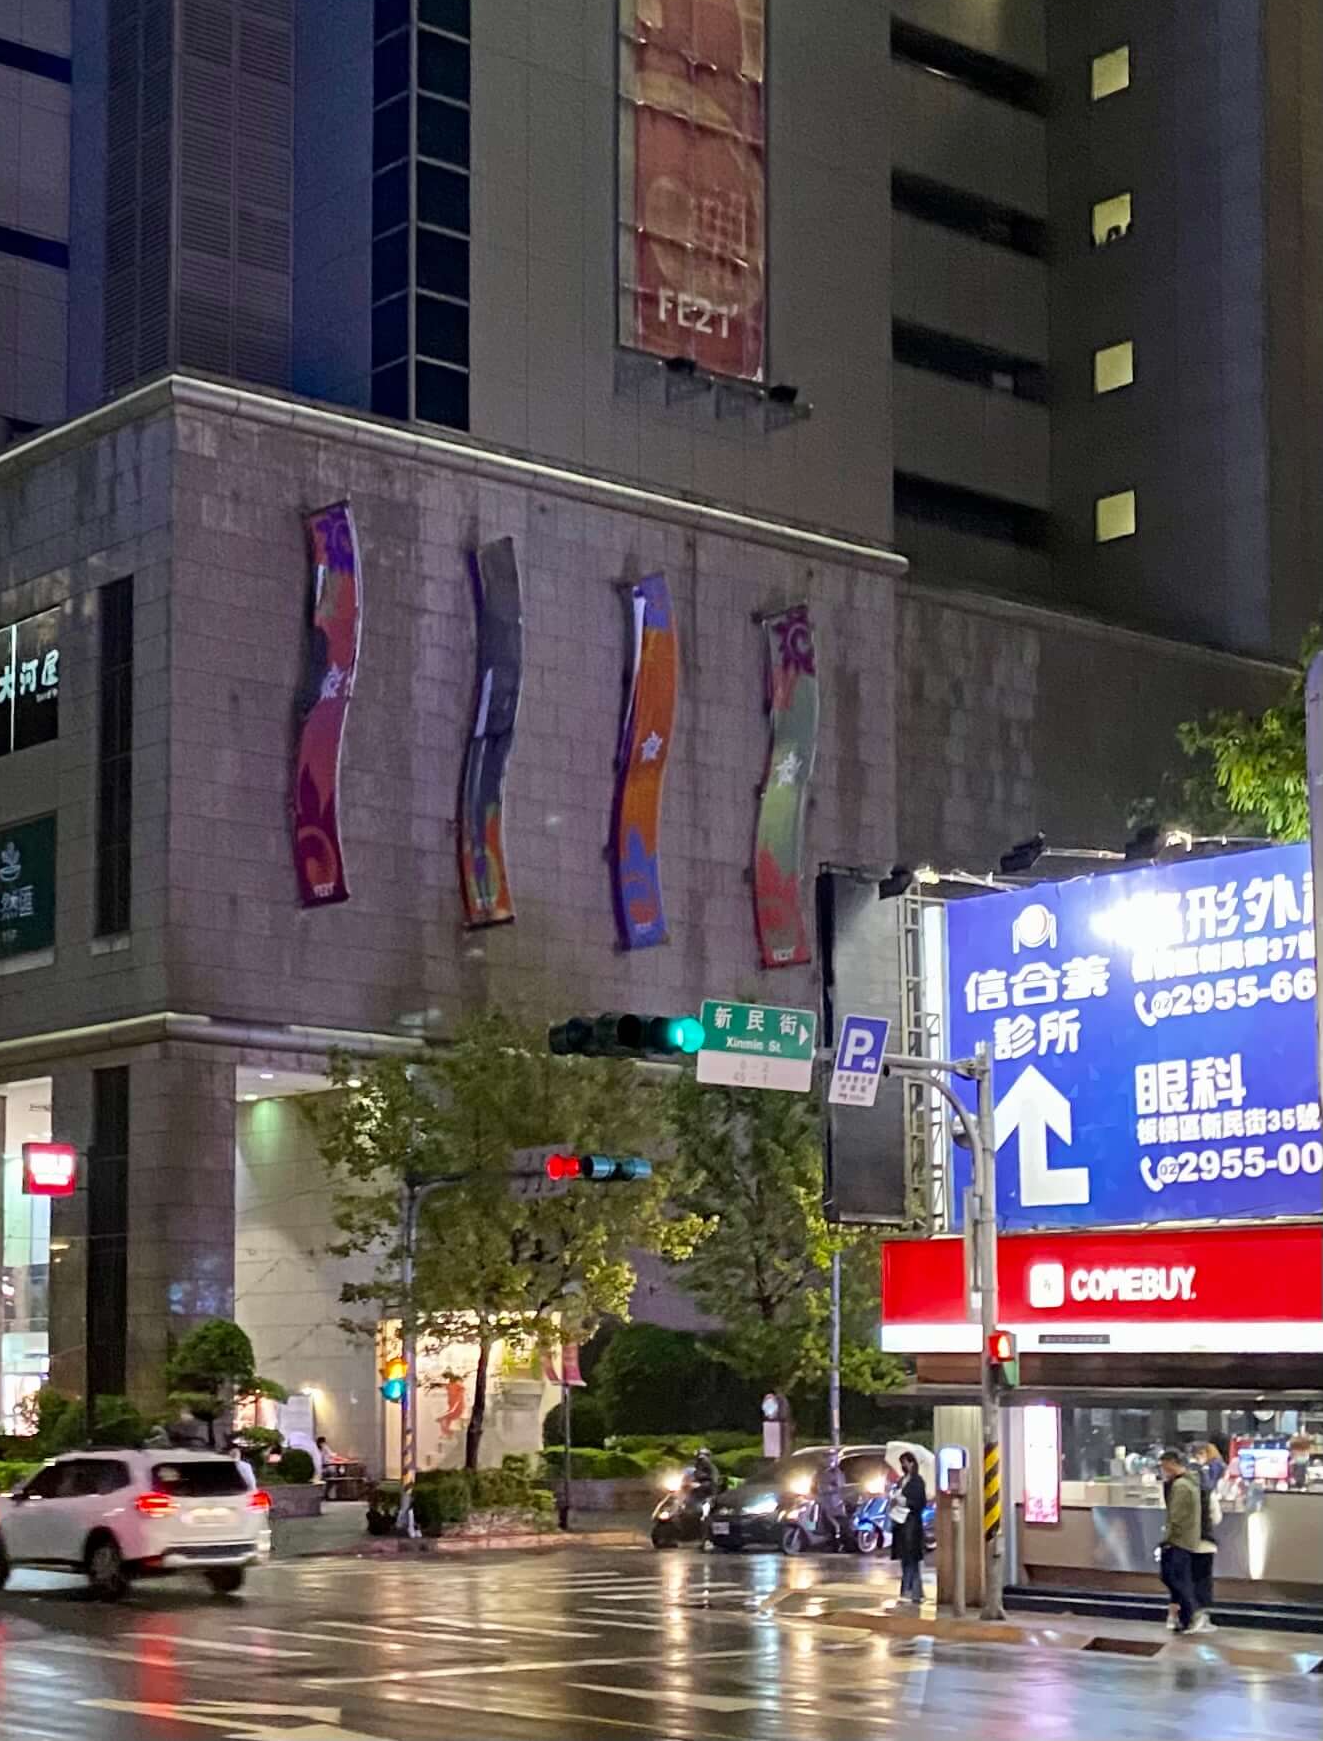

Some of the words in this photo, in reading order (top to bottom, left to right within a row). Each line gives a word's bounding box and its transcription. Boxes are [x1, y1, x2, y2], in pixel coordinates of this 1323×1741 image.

[1124, 871, 1314, 952] 形外
[714, 1006, 797, 1036] 新民街
[993, 1008, 1082, 1061] 診所
[725, 1035, 764, 1051] Xinmin
[843, 1027, 875, 1068] P
[1135, 1052, 1247, 1116] 眼科
[1070, 1265, 1196, 1302] COMEBUY
